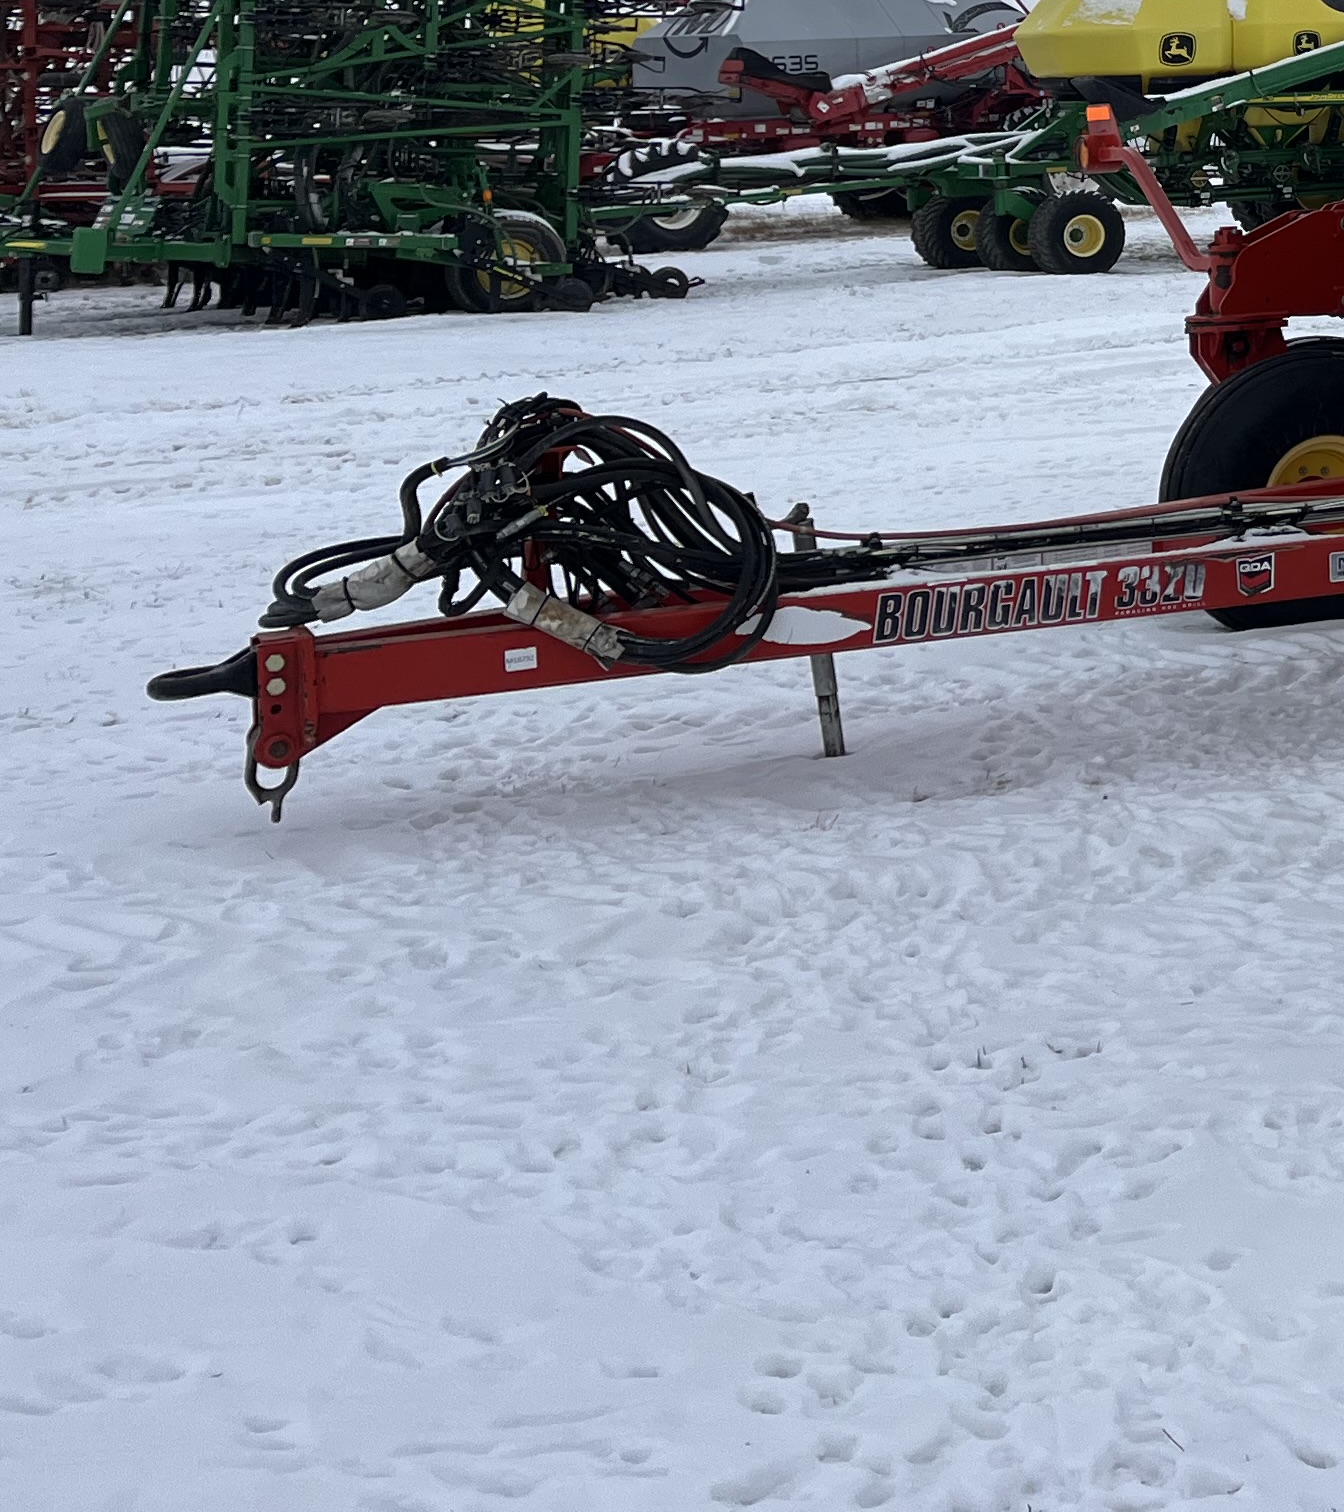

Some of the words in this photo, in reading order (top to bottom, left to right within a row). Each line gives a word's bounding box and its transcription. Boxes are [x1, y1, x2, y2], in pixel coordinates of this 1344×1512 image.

[765, 54, 819, 72] 535
[873, 570, 1108, 645] BOURGAULT
[1114, 564, 1206, 609] 3320
